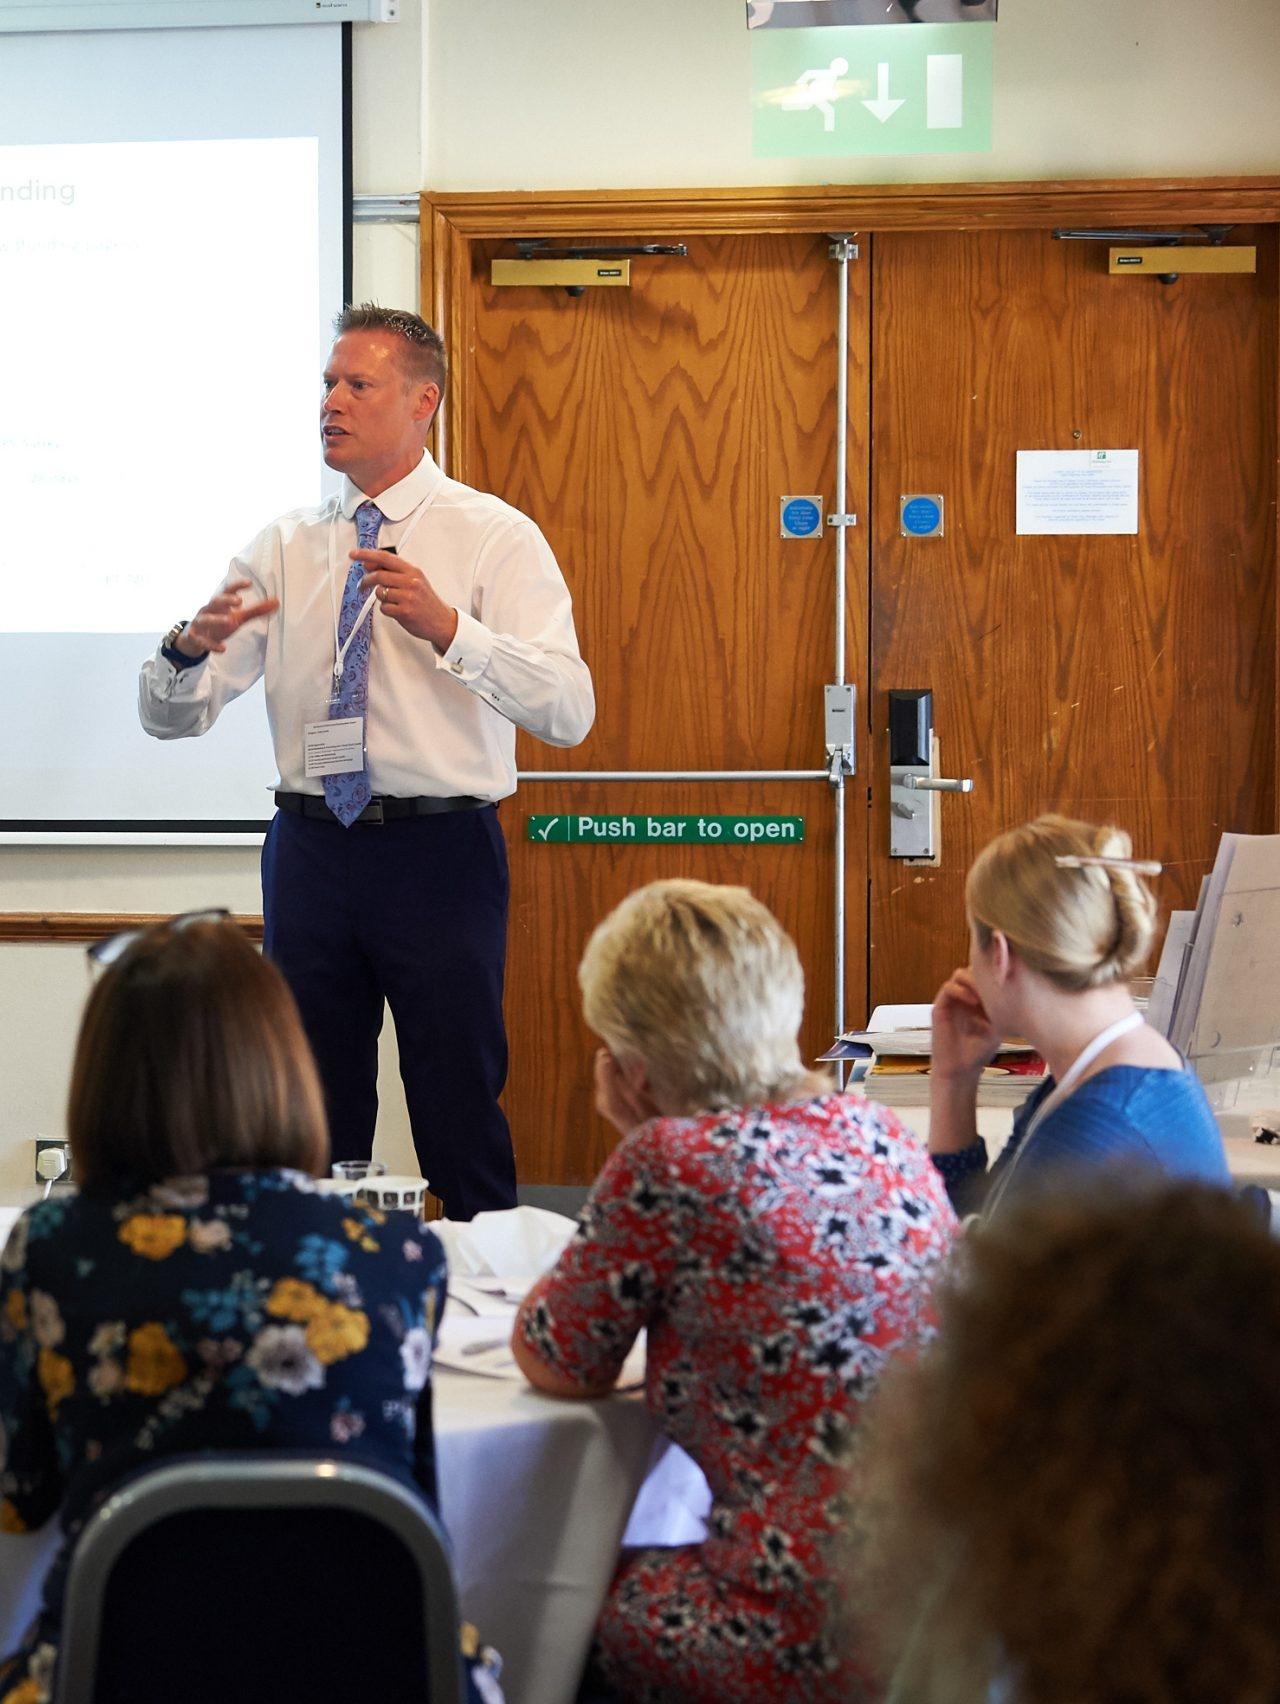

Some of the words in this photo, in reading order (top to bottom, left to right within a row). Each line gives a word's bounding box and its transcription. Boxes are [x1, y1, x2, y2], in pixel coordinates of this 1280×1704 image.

[578, 817, 635, 837] Push
[647, 817, 686, 837] bar
[697, 819, 722, 837] to
[734, 822, 795, 841] open
